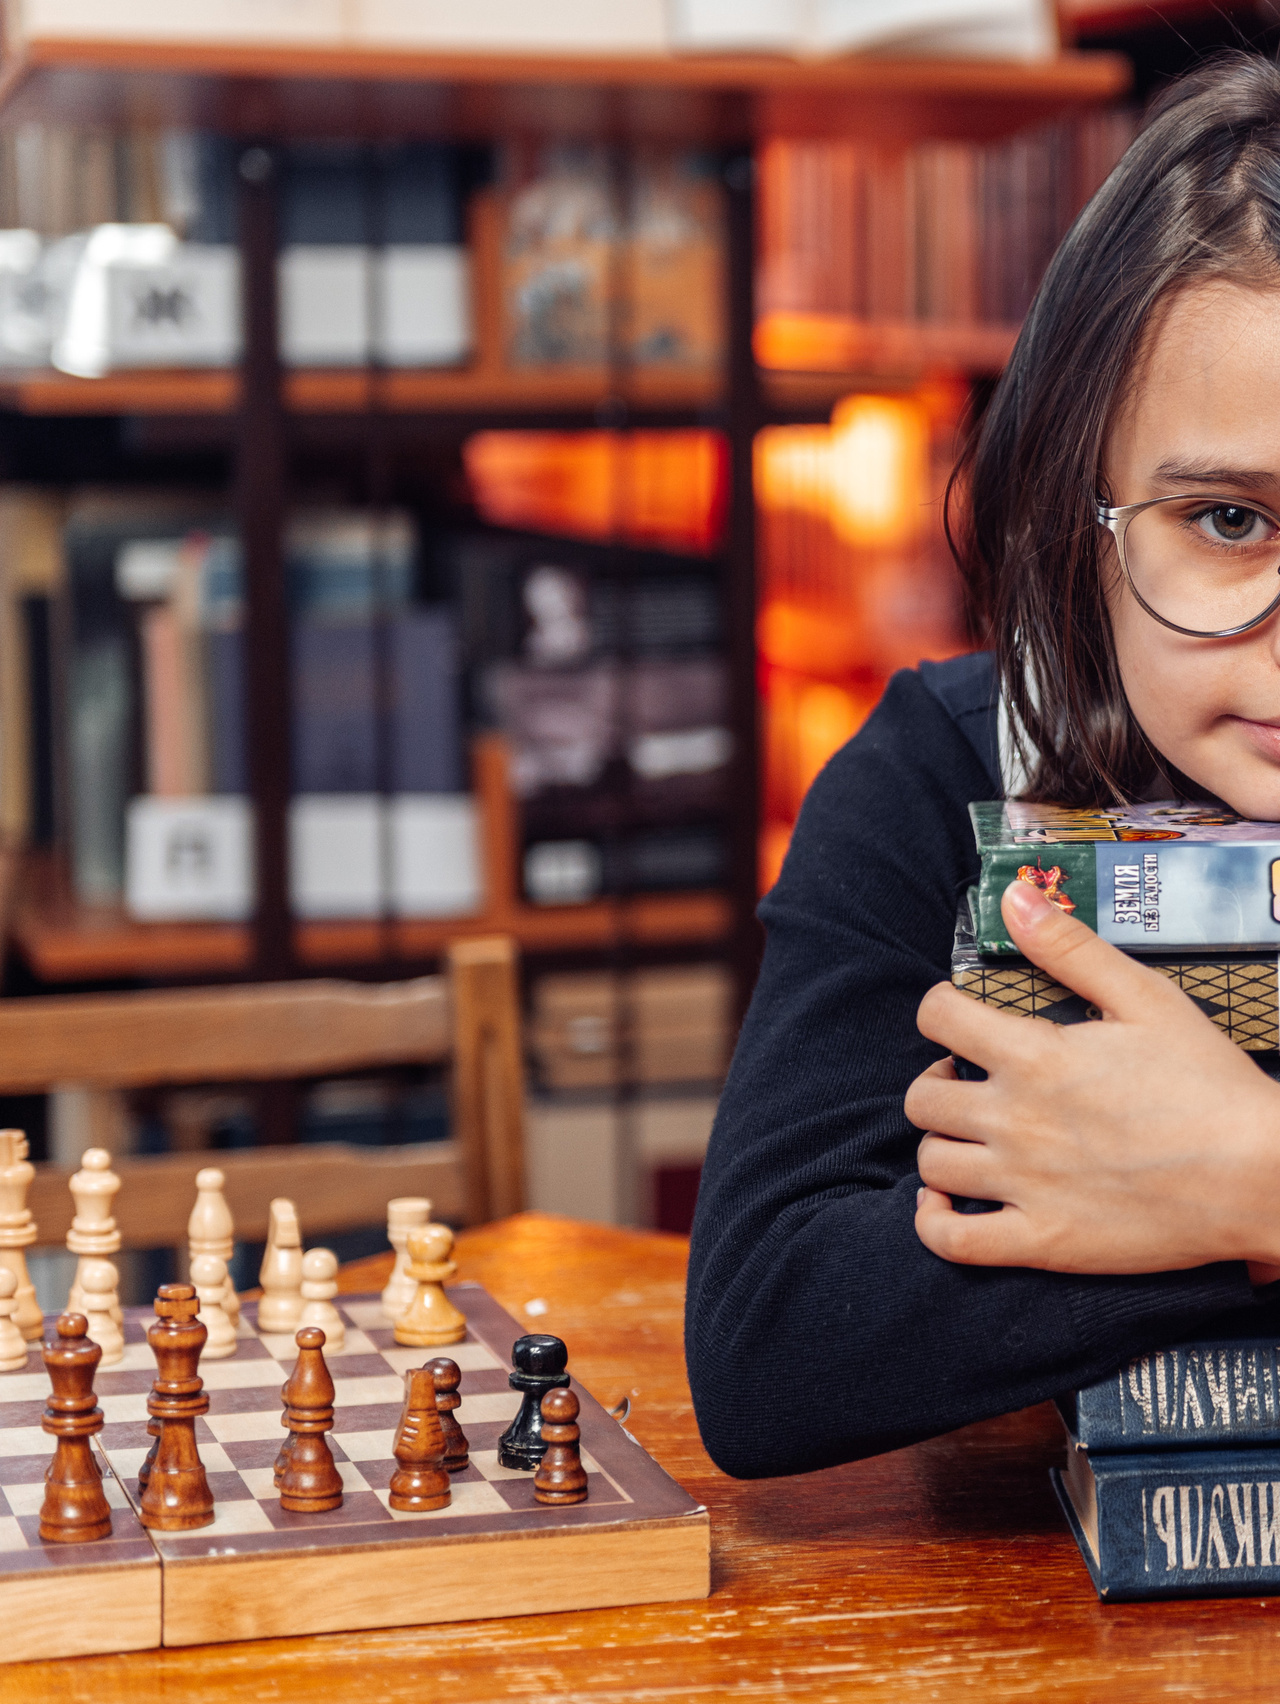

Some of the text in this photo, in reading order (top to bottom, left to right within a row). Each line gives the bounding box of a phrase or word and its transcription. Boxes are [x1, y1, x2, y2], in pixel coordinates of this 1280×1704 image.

[1112, 864, 1143, 923] ЗЕМЛЯ
[1143, 854, 1161, 932] БЕЗ РАДОСТИ
